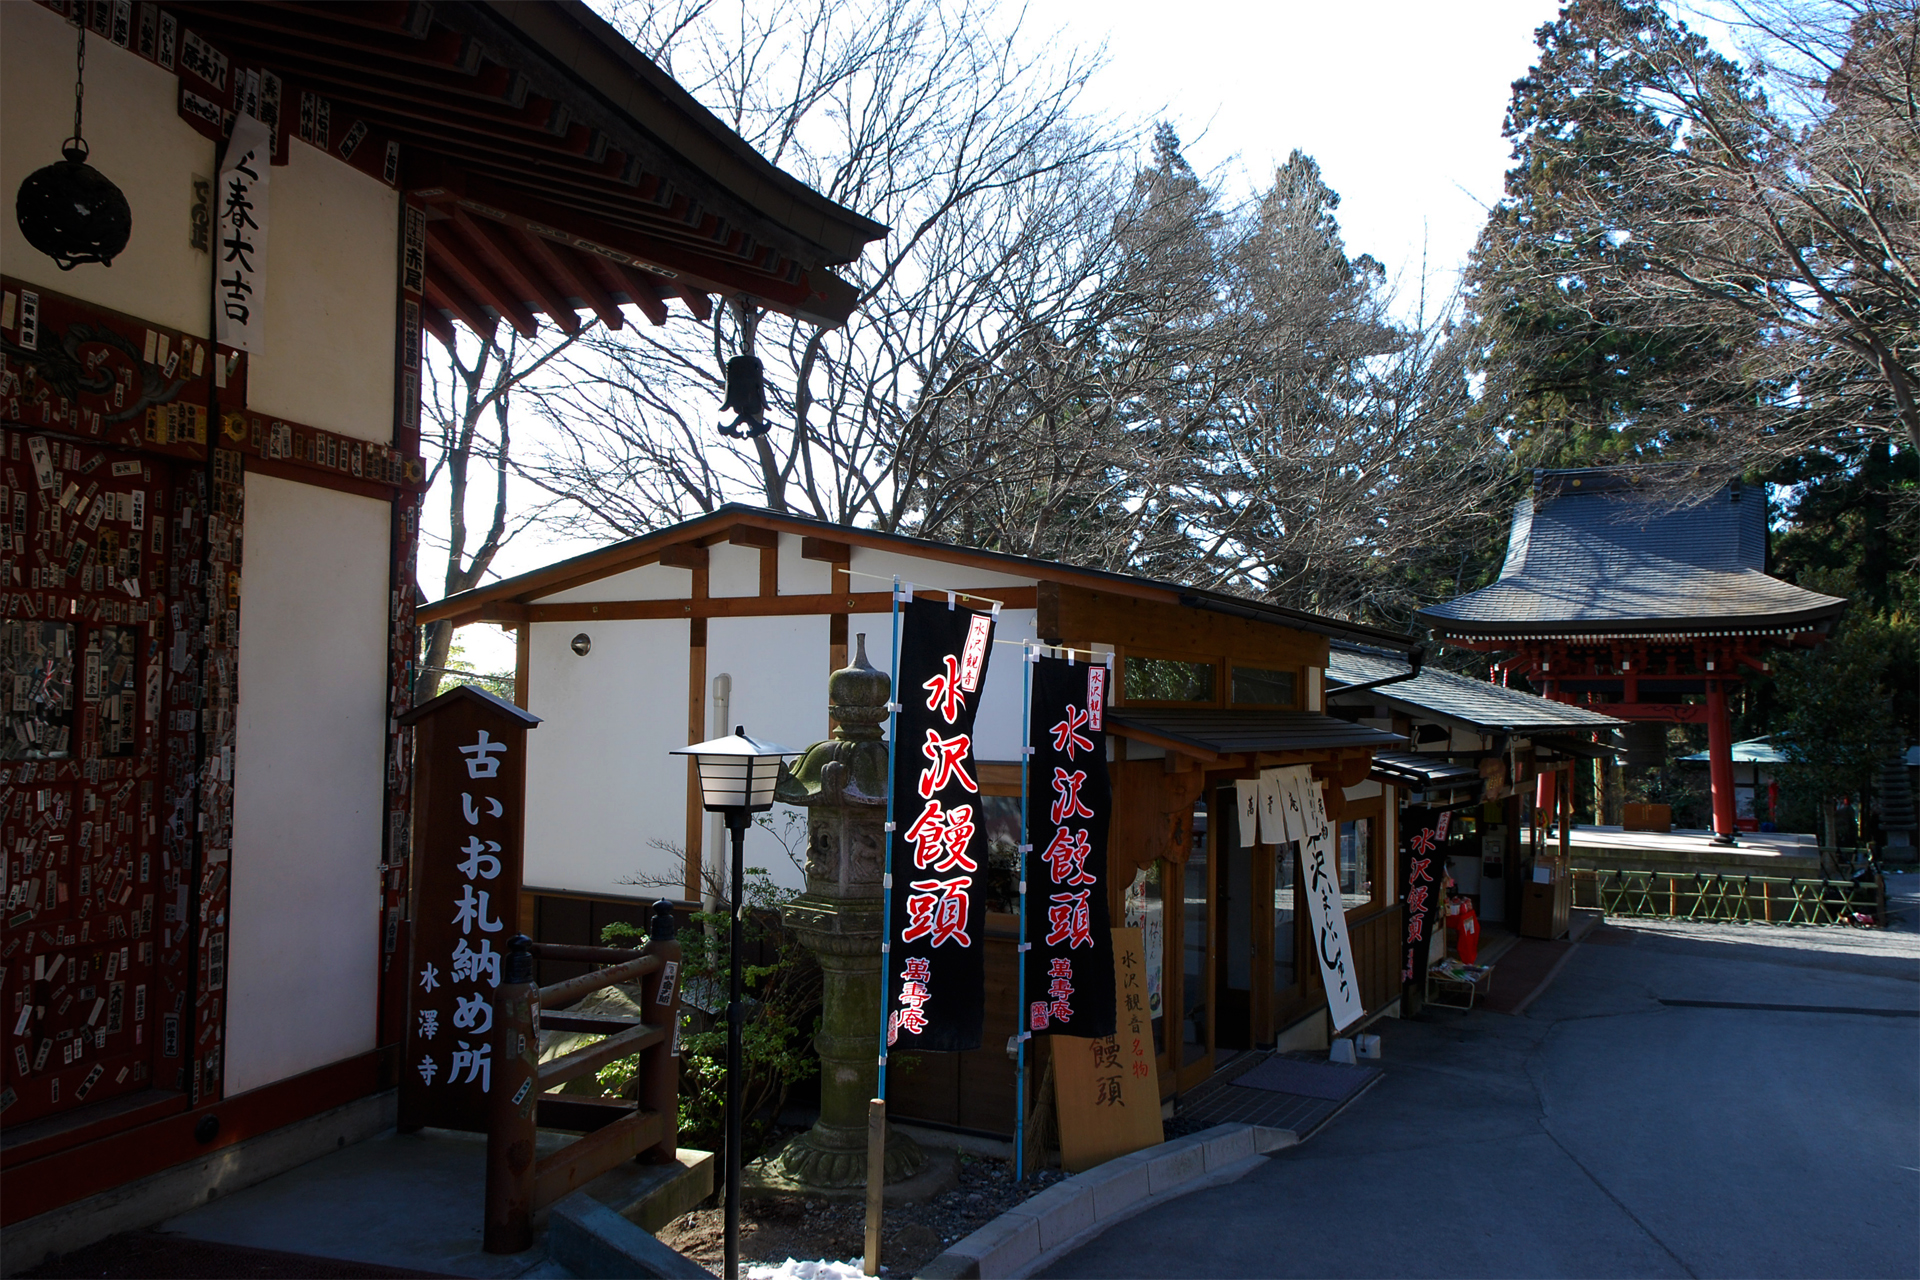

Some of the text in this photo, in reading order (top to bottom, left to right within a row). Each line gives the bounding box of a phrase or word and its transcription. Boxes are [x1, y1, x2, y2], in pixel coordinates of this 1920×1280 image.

[962, 622, 985, 685] 水沢観音
[1090, 671, 1102, 725] 水沢観音
[902, 654, 978, 948] 水沢饅頭
[1042, 704, 1097, 950] 水沢饅頭
[447, 730, 508, 1093] 古いお札納め所
[417, 962, 441, 1087] 水澤寺
[1089, 1034, 1125, 1108] 饅頭
